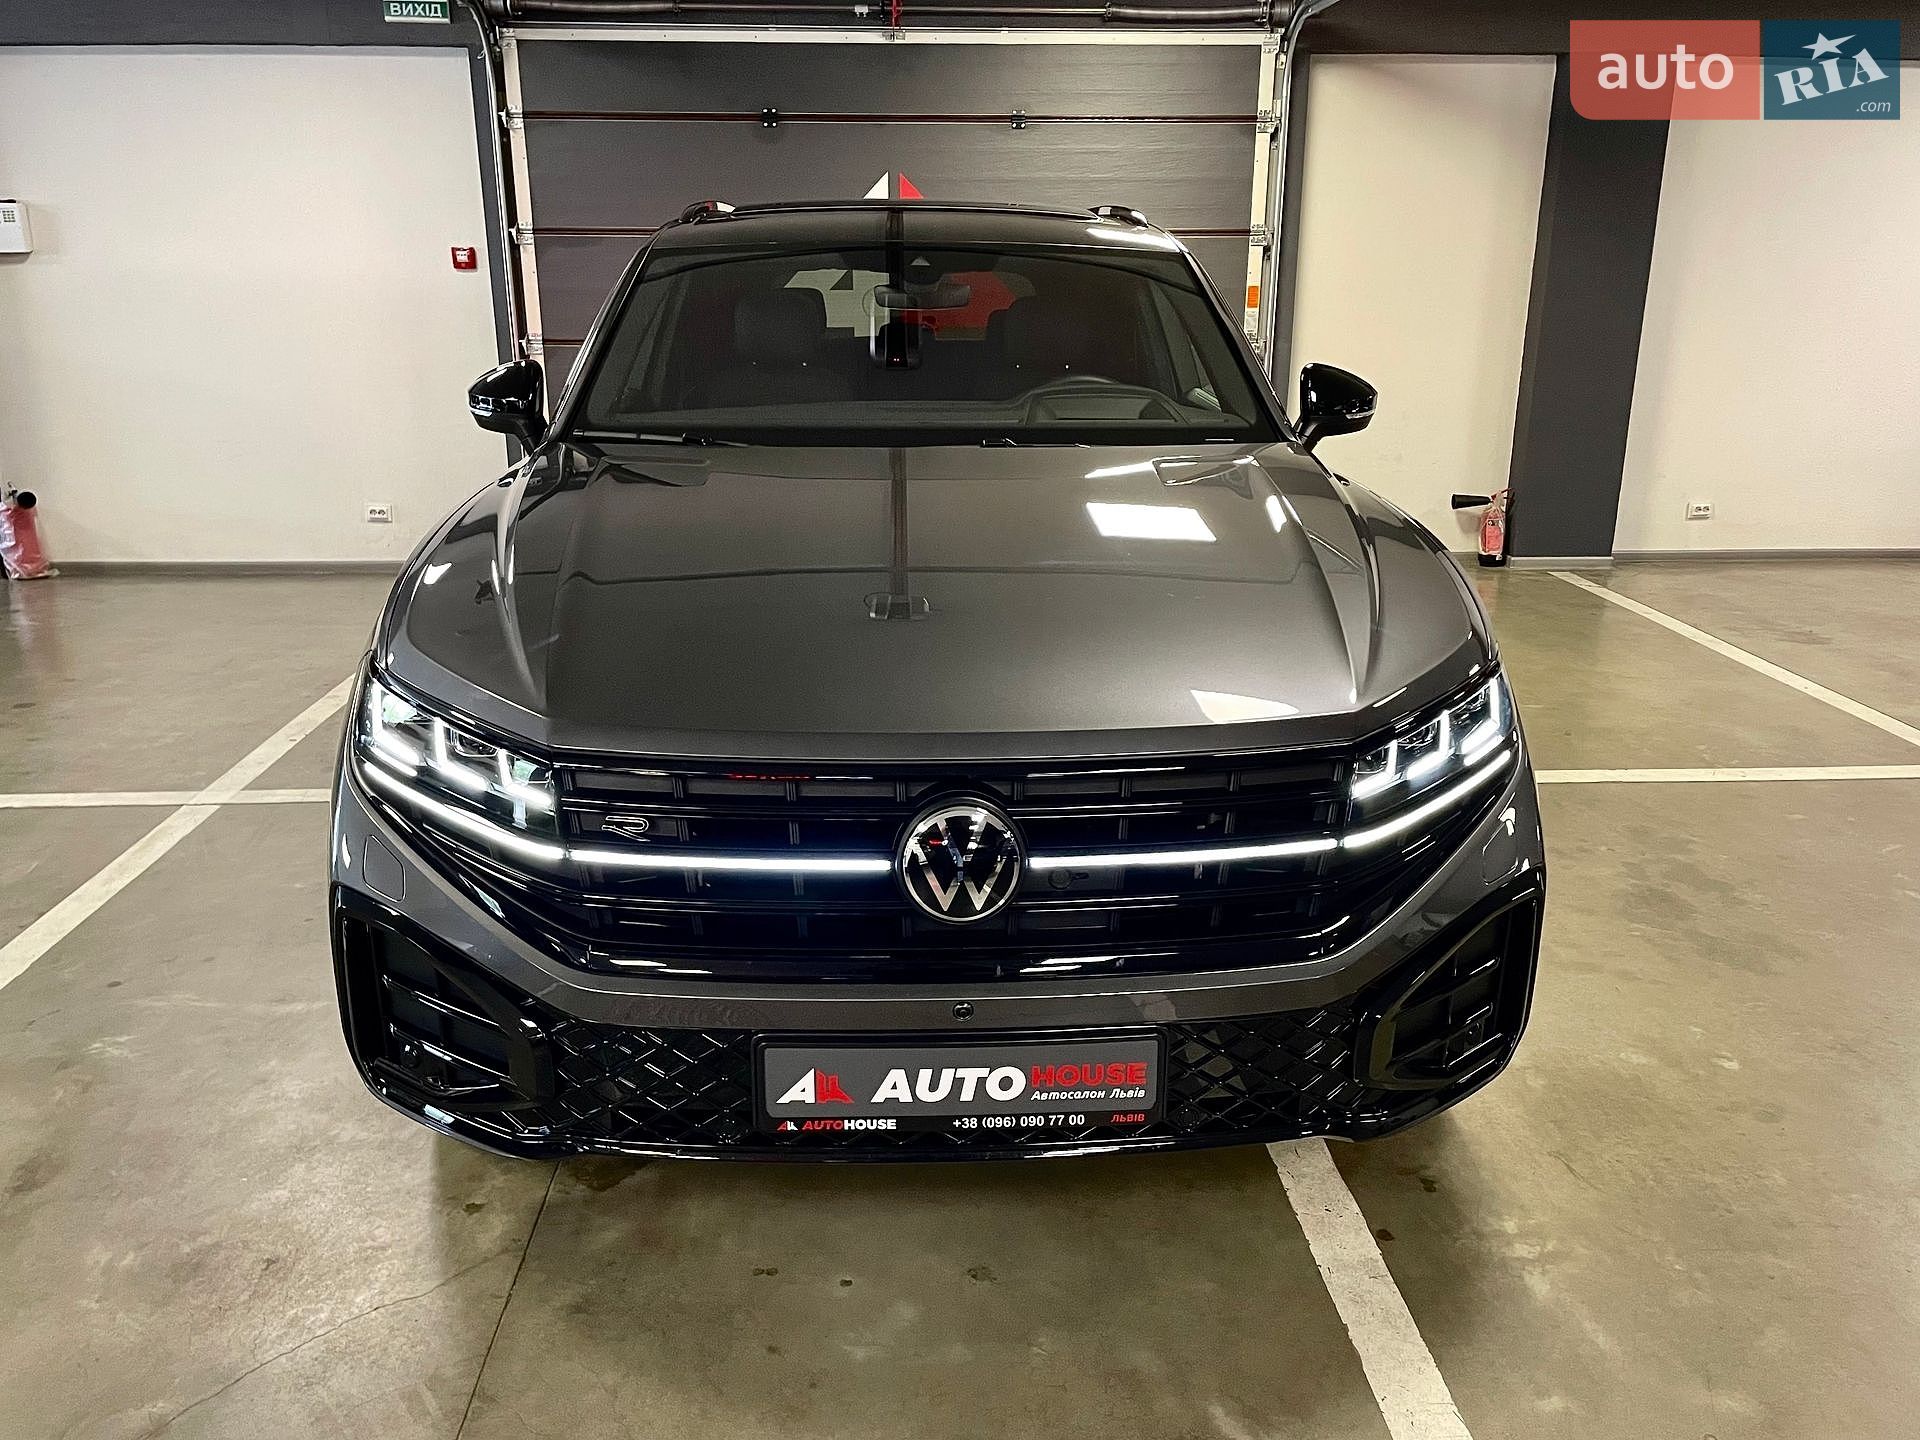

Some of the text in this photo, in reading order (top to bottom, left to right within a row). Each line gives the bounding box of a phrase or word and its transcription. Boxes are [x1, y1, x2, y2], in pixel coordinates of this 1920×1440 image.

[389, 2, 442, 17] ВИХІД
[870, 1062, 1148, 1103] AUTO HOUSE
[1030, 1086, 1146, 1101] Автосалон Львів
[801, 1118, 897, 1131] AUTOHOUSE
[952, 1114, 1085, 1129] +38 (096) 090 77 00
[1110, 1113, 1146, 1123] ЛЬВІВ
